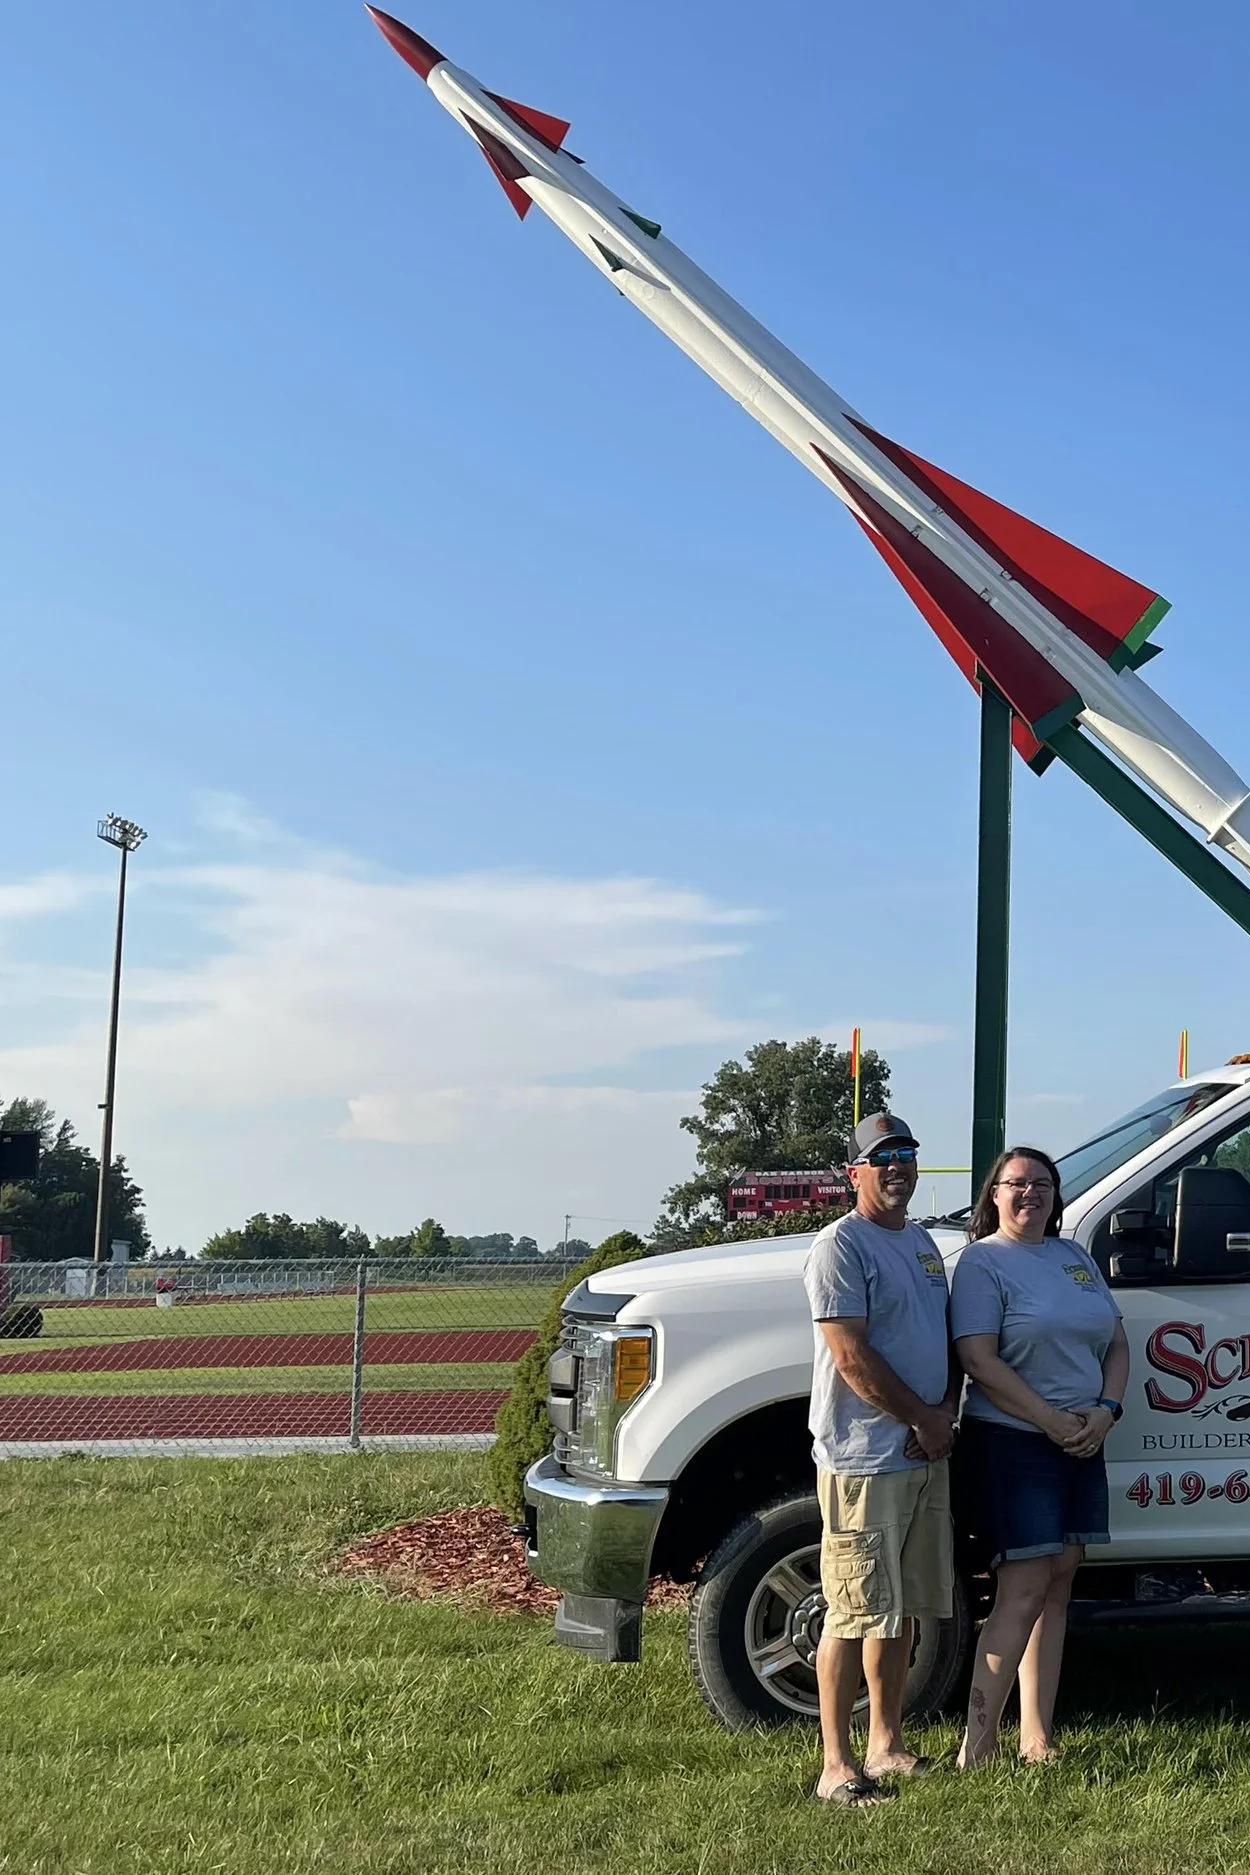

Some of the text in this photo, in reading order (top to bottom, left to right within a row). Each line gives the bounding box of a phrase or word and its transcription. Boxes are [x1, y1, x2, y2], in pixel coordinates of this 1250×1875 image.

[731, 1187, 757, 1195] HOME
[817, 1186, 846, 1194] VISITOR
[737, 1211, 758, 1220] DOWN
